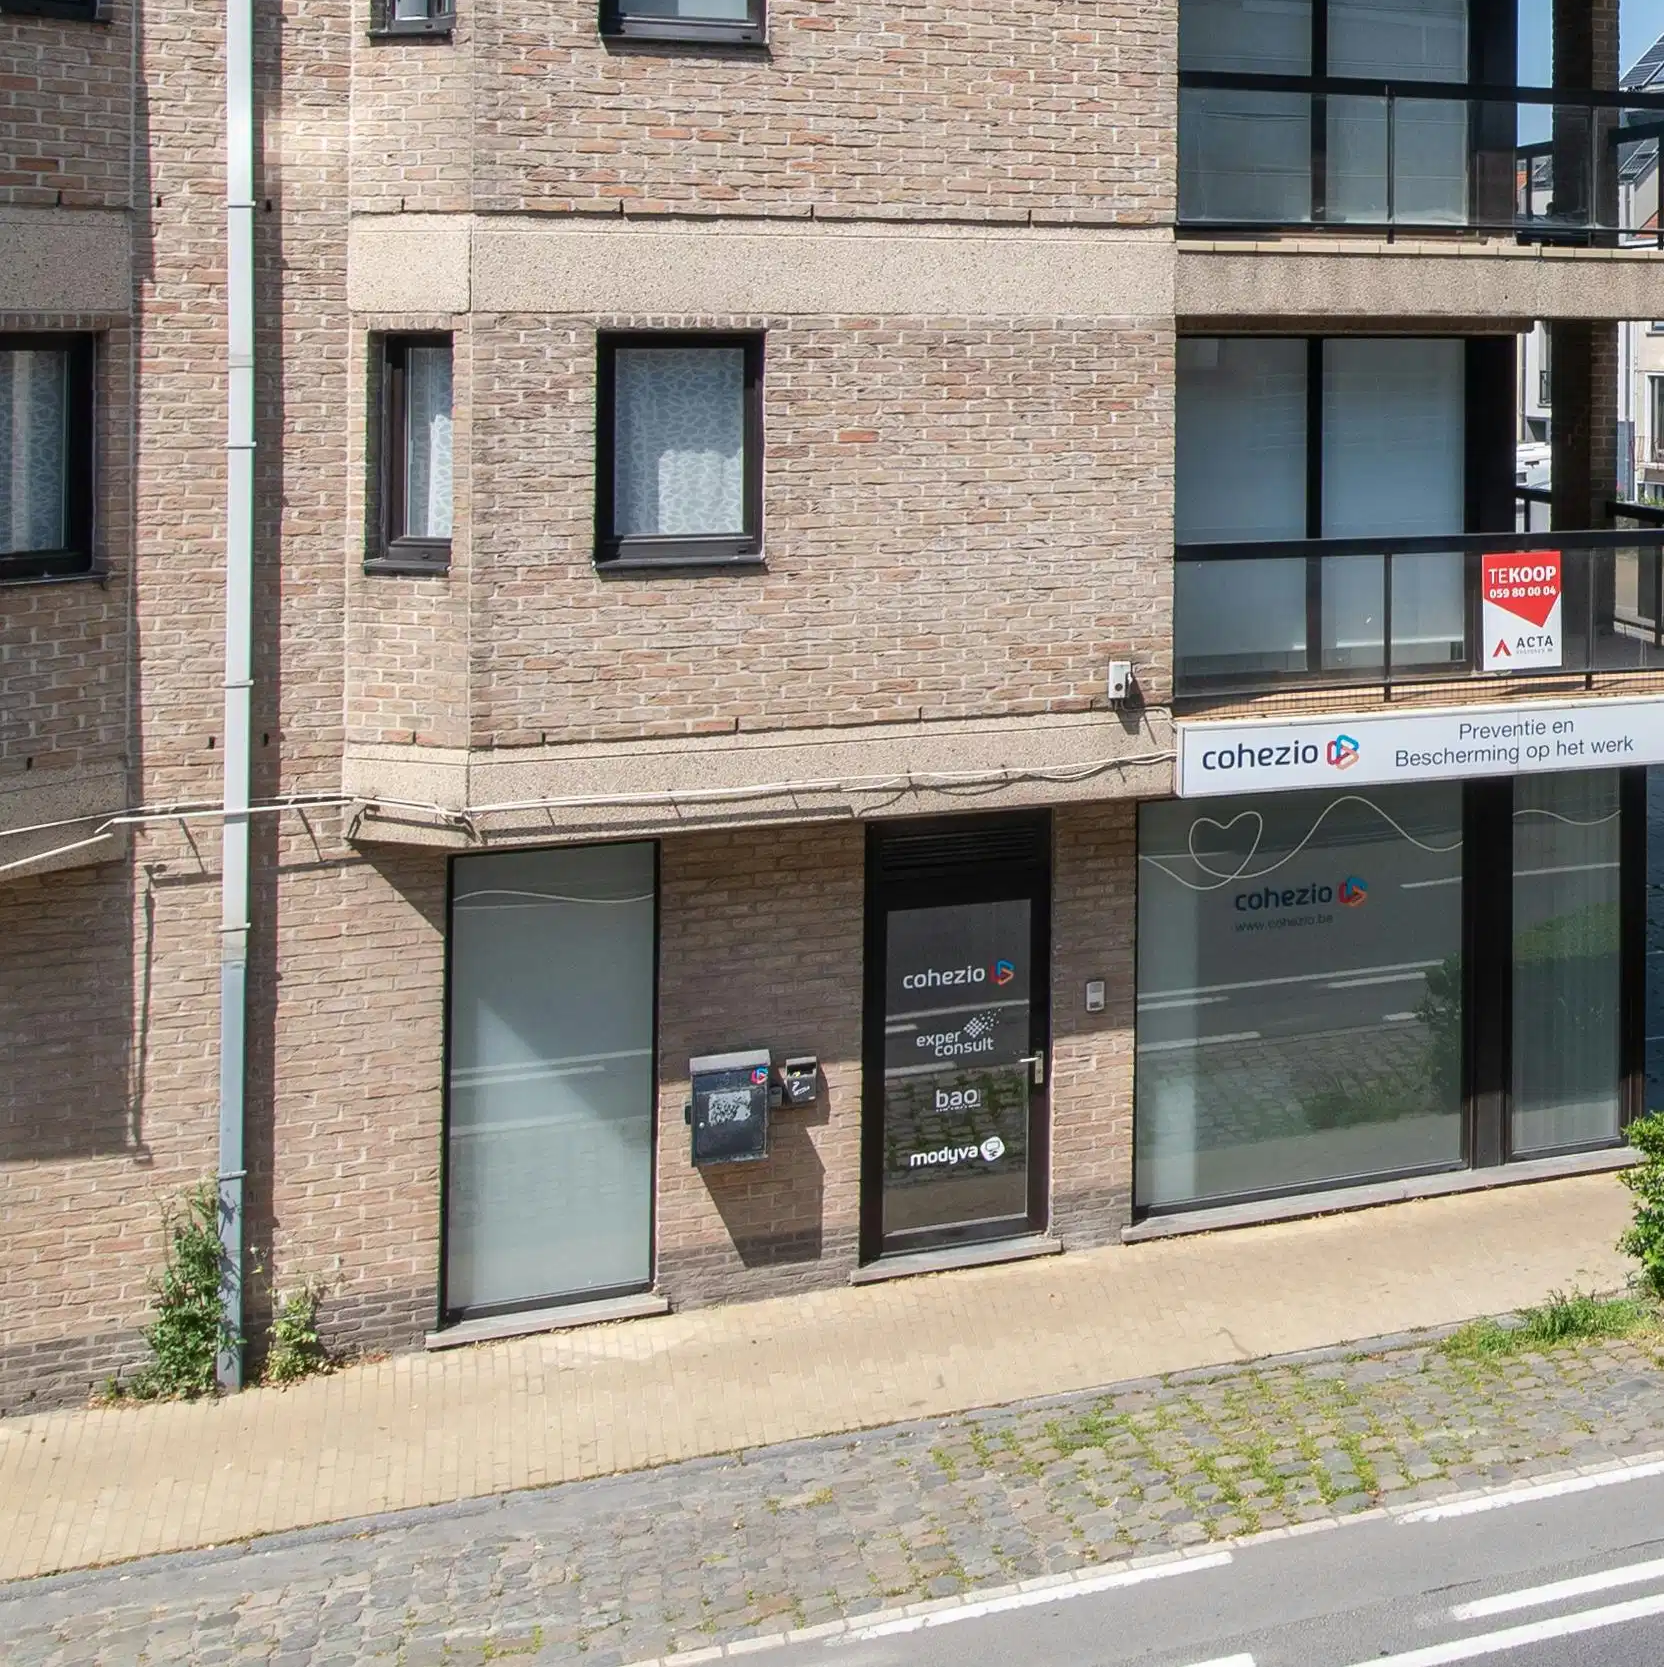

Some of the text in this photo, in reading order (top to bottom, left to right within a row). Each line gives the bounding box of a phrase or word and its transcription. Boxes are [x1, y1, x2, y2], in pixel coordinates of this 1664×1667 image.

[1489, 585, 1557, 599] 059 80 00 04
[1516, 634, 1554, 649] ACTA
[1458, 720, 1574, 740] Preventie en
[1202, 740, 1319, 770] cohezio
[1395, 735, 1634, 767] Bescherming op het werk
[1235, 882, 1333, 911] cohezio
[903, 965, 986, 989] cohezio
[916, 1031, 962, 1047] exper
[935, 1037, 994, 1057] consult
[910, 1145, 979, 1167] modyva
